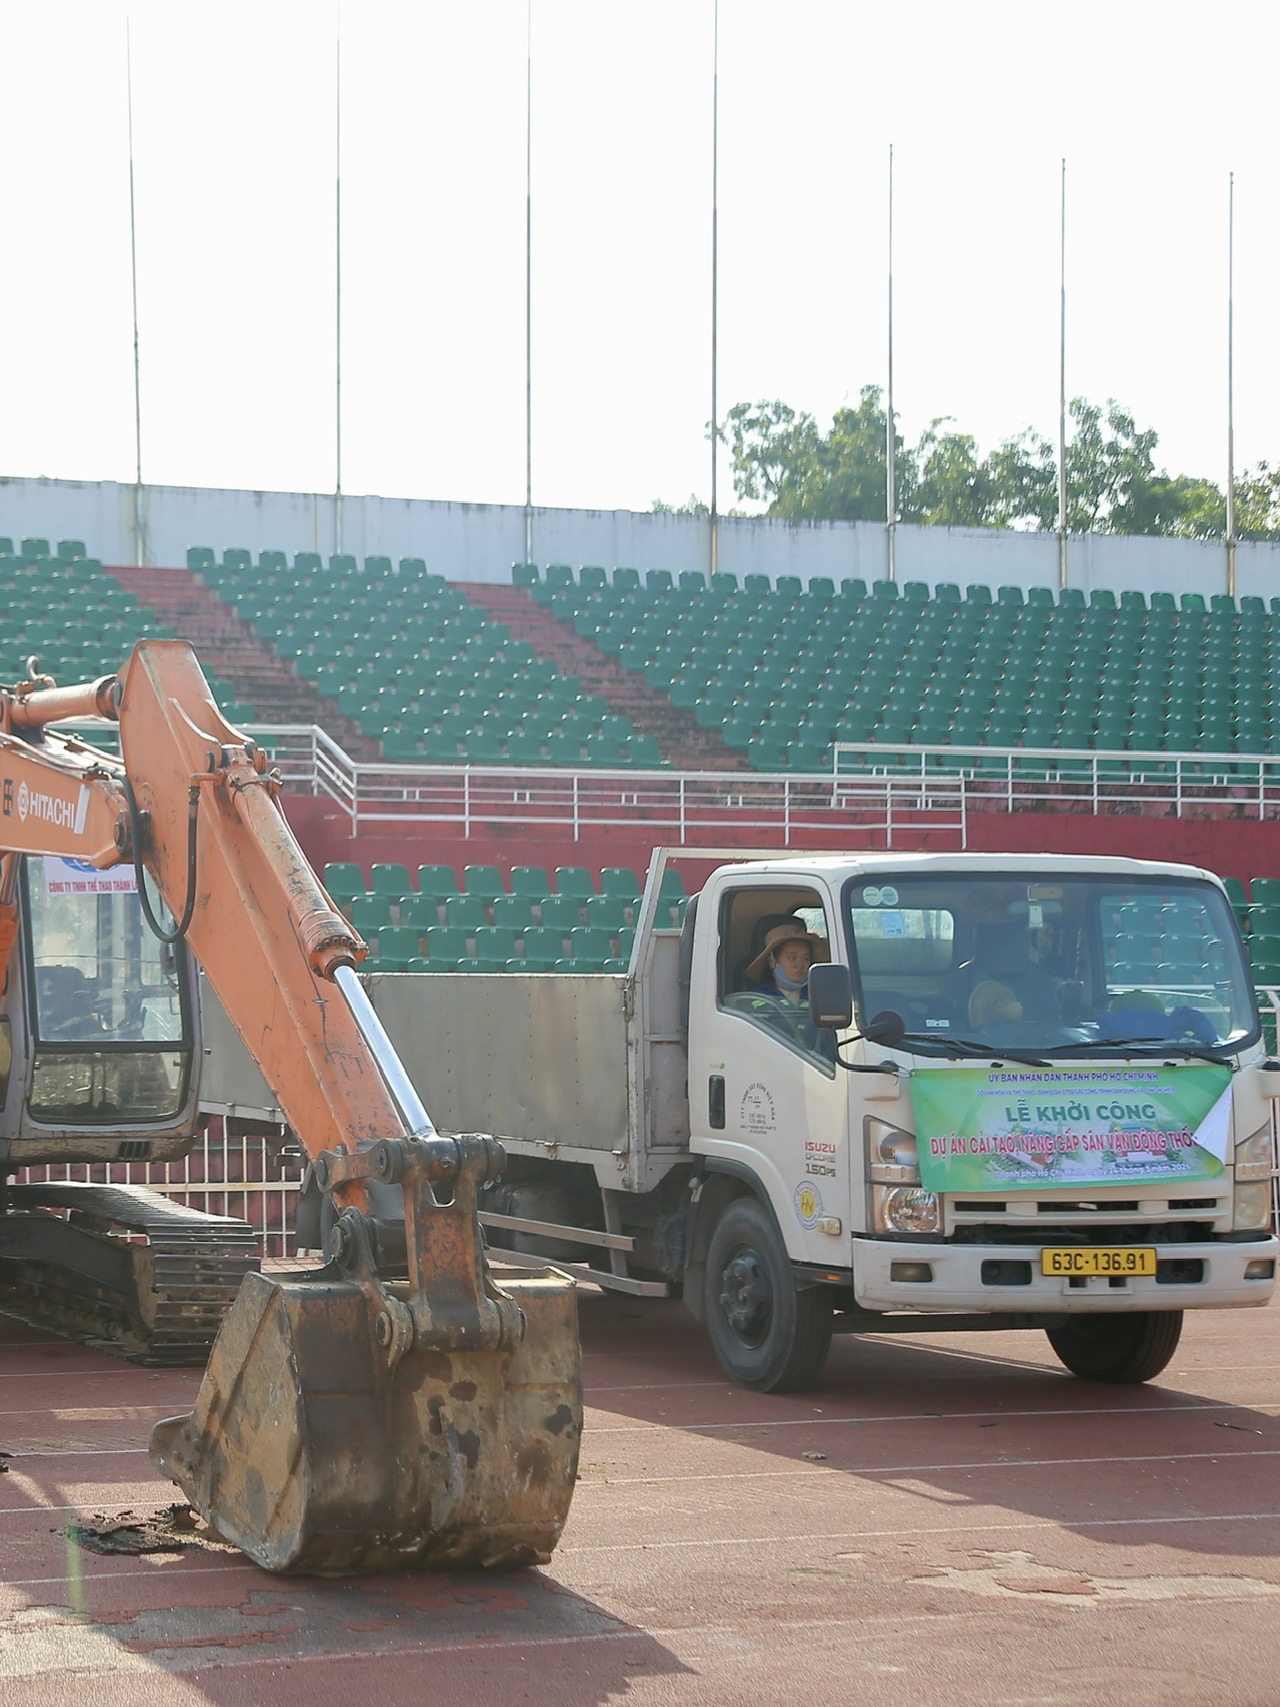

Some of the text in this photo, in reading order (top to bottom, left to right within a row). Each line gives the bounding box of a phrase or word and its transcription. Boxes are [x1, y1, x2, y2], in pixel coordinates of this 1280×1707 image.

[30, 791, 75, 829] HITACHI
[1001, 1073, 1018, 1082] BAN
[1020, 1070, 1041, 1082] NHÂN
[1044, 1070, 1061, 1082] DÂN
[1063, 1070, 1089, 1081] THÀNH
[1138, 1071, 1158, 1081] MINH
[1006, 1099, 1156, 1122] LỄ KHỞI CÔNG
[805, 1141, 836, 1153] ISUZU
[930, 1136, 946, 1159] DỰ
[951, 1133, 966, 1155] ÁN
[970, 1131, 990, 1155] CẢI
[993, 1136, 1019, 1159] TẠO,
[1021, 1132, 1053, 1155] NÂNG
[1056, 1127, 1079, 1152] CẤP
[1082, 1130, 1105, 1151] SÂN
[1106, 1130, 1130, 1156] VẬN
[1133, 1129, 1167, 1154] ĐỘNG
[1052, 1253, 1145, 1270] 63C-136.91
